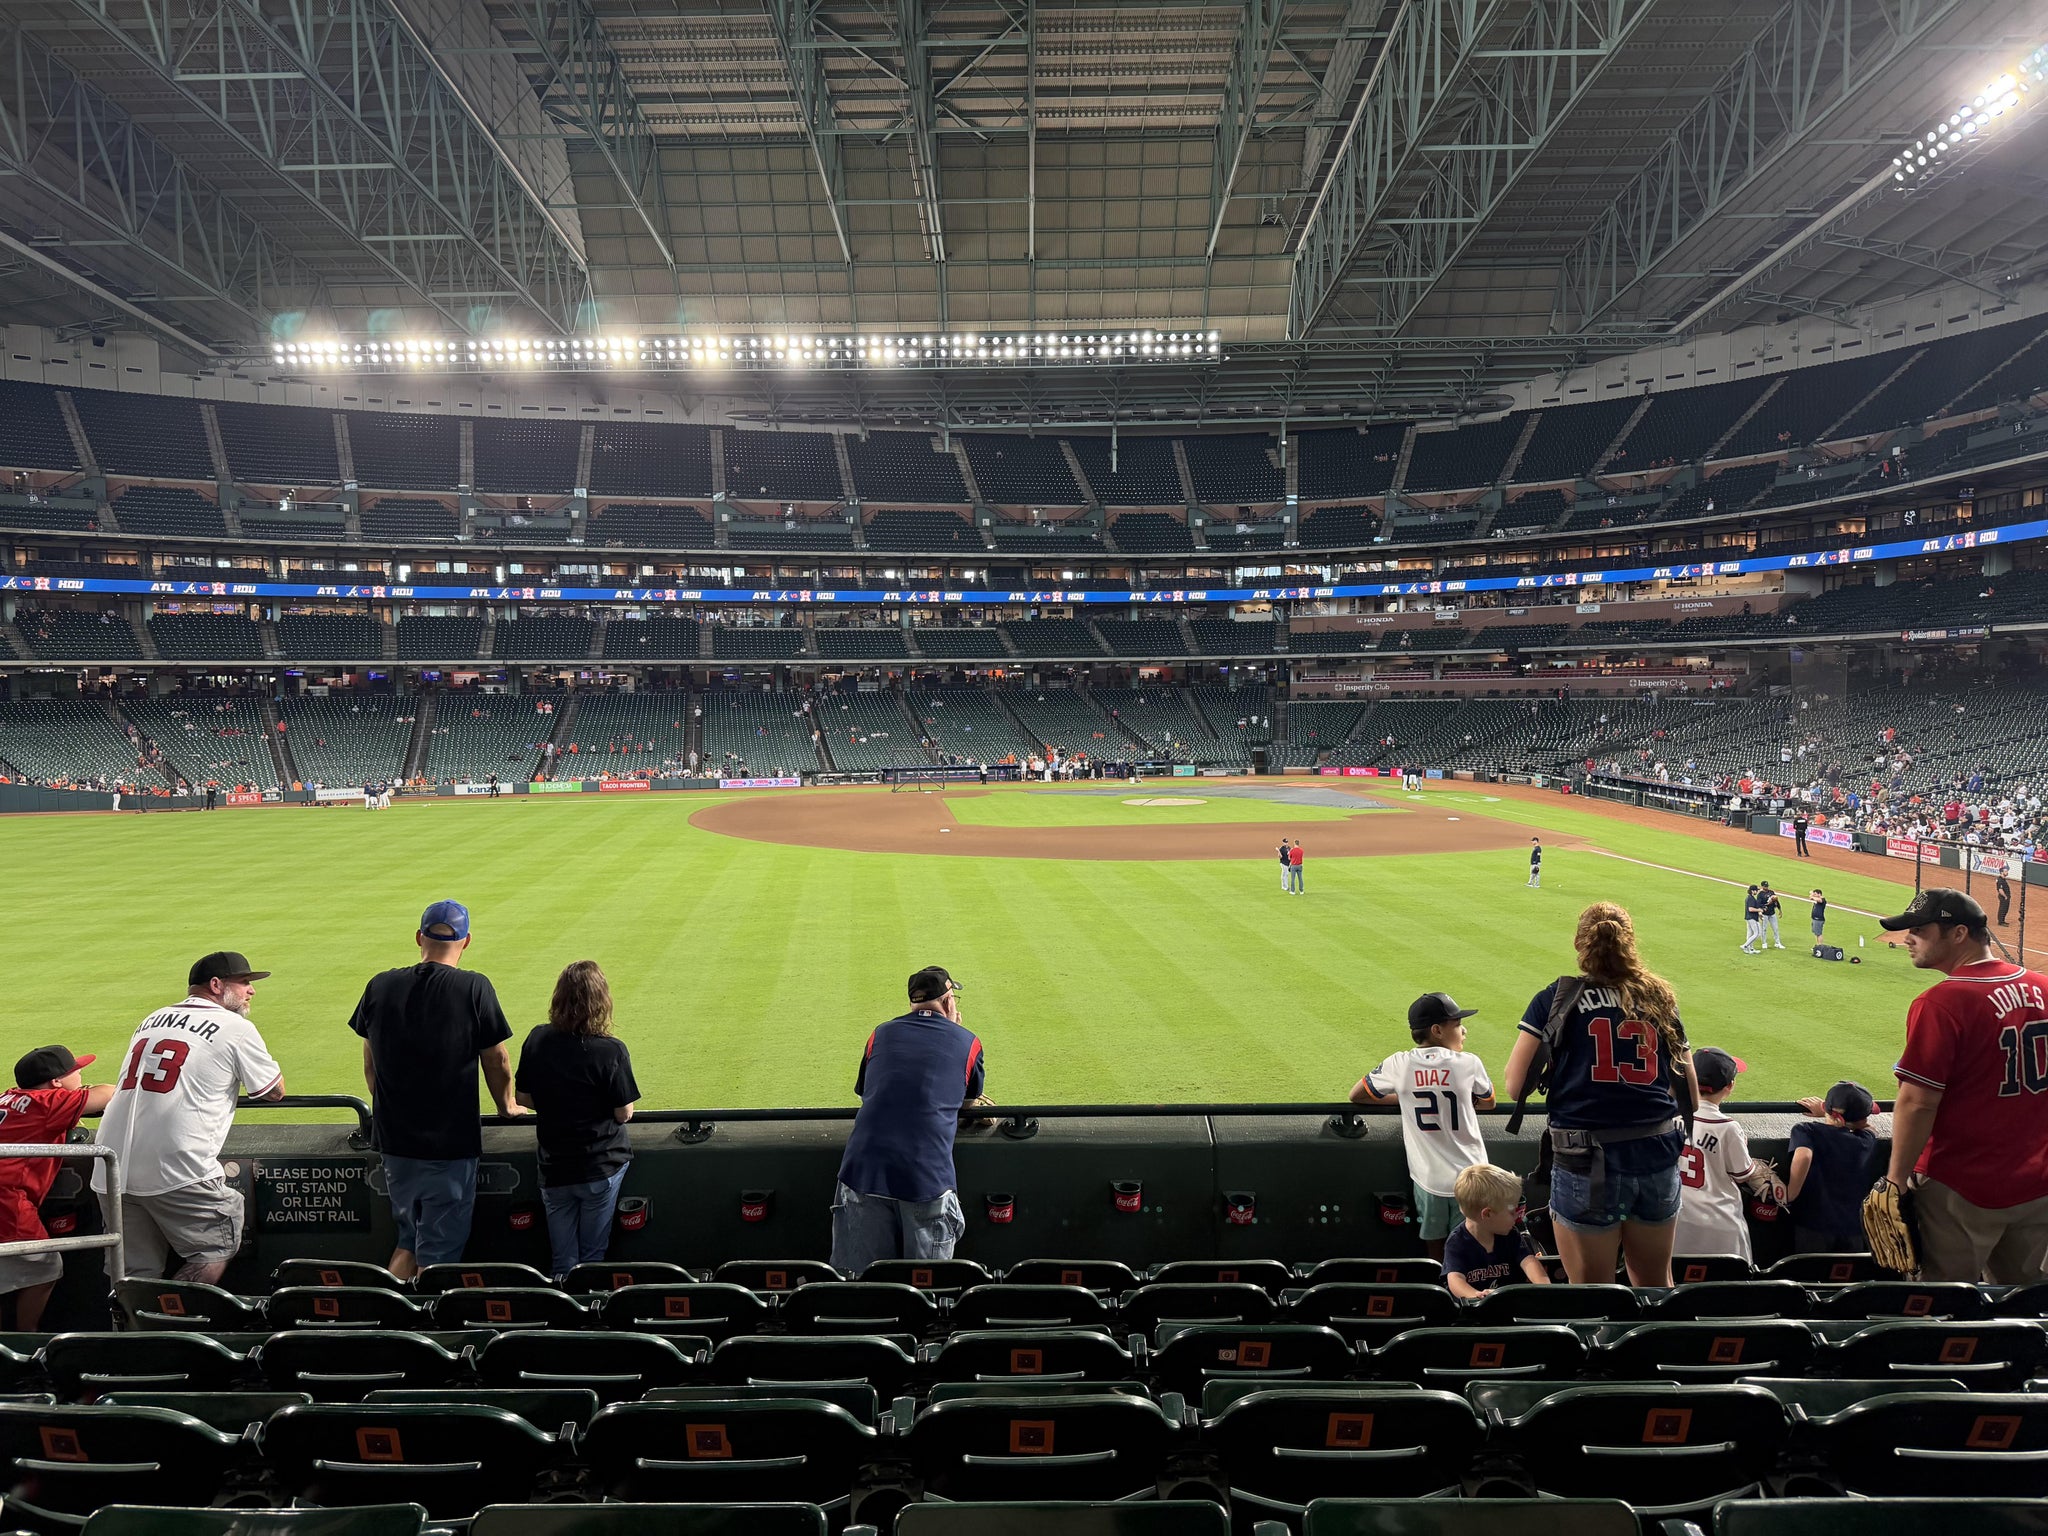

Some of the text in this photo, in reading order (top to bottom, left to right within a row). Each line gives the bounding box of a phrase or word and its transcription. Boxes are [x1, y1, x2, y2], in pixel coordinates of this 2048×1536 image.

[1923, 540, 1940, 551] ATL
[1980, 531, 1998, 543] HOU
[1789, 556, 1808, 565] ATL
[1854, 549, 1872, 559] HOU
[1654, 569, 1671, 577] ATL
[1720, 563, 1739, 572] HOU
[58, 580, 84, 589] HOU
[1447, 582, 1465, 590] HOU
[1517, 578, 1535, 586] ATL
[1583, 574, 1602, 582] HOU
[151, 583, 174, 591] ATL
[233, 585, 256, 593] HOU
[392, 588, 413, 596] HOU
[1637, 679, 1669, 688] Insperity
[1982, 857, 2005, 868] ARROW
[1987, 983, 2045, 1020] JONES
[189, 1019, 220, 1043] JR.
[1588, 1017, 1659, 1085] 13
[1998, 1019, 2048, 1097] 10
[121, 1038, 191, 1094] 13
[1414, 1069, 1450, 1087] DIAZ
[1412, 1091, 1459, 1131] 21
[1697, 1132, 1719, 1154] JR.
[257, 1168, 363, 1179] PLEASE DO NOT
[1680, 1145, 1705, 1189] 3
[275, 1182, 347, 1195] SIT, STAND
[282, 1197, 342, 1208] OR LEAN
[266, 1211, 360, 1222] AGAINST RAIL
[1466, 1263, 1510, 1283] ATLANT
